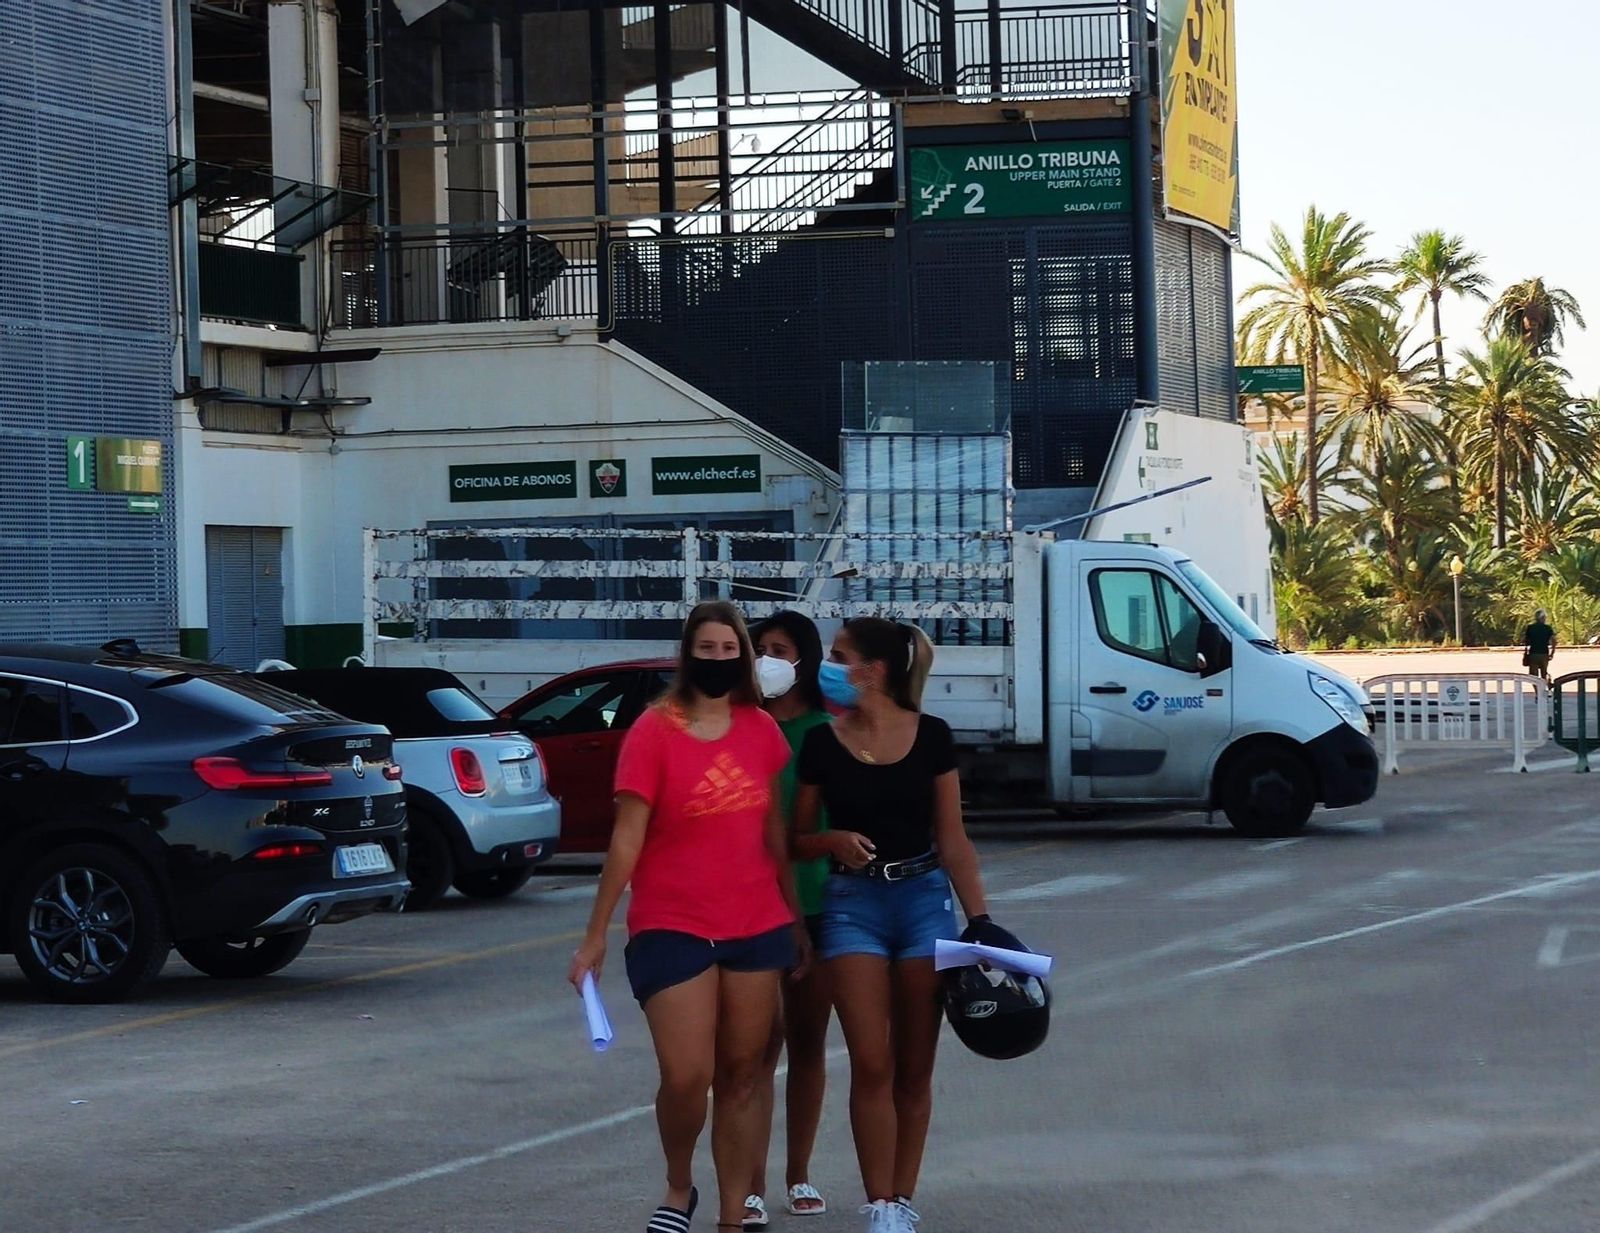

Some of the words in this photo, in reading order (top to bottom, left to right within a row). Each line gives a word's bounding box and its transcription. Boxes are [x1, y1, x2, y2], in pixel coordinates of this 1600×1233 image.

[965, 153, 1034, 172] ANILLO
[1038, 150, 1121, 169] TRIBUNA
[1009, 171, 1046, 182] UPPER
[1049, 169, 1080, 180] MAIN
[1082, 168, 1121, 179] STAND
[1047, 180, 1082, 190] PUERTA
[1090, 178, 1114, 187] GATE
[1115, 178, 1122, 187] 2
[963, 182, 986, 215] 2
[1064, 203, 1096, 213] SALIDA
[1103, 202, 1122, 211] EXIT
[73, 441, 85, 484] 1
[454, 475, 501, 489] OFICINA
[503, 475, 520, 487] DE
[521, 473, 572, 487] ABONOS
[656, 466, 757, 482] www.elchecf.es
